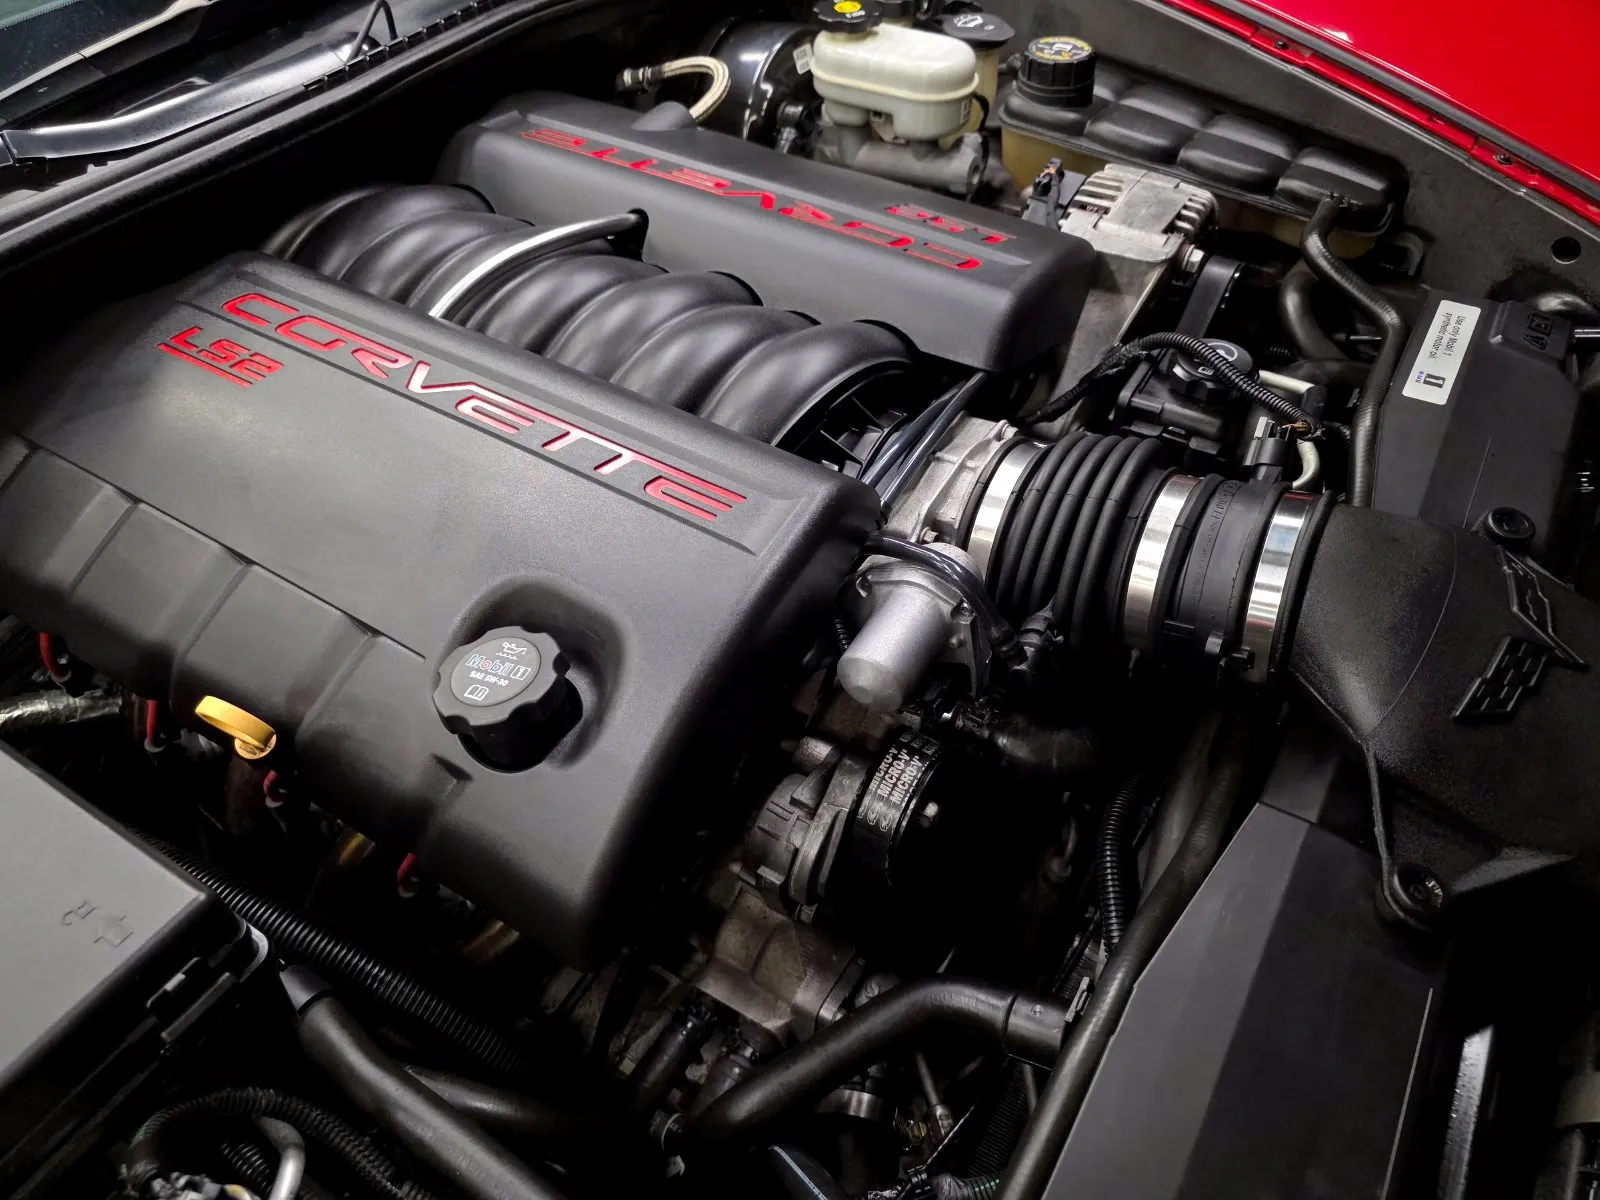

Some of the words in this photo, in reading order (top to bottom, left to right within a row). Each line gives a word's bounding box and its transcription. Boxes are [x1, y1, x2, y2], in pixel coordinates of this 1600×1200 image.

[520, 128, 984, 270] CORVETTE
[1439, 312, 1453, 335] synthetic
[1455, 315, 1467, 326] Use
[1449, 326, 1461, 337] only
[1432, 335, 1444, 351] motor
[1445, 337, 1458, 352] Mobil
[168, 325, 285, 383] LS2
[221, 292, 748, 521] CORVETTE
[465, 653, 515, 676] Mobil
[469, 670, 486, 681] SAE
[484, 674, 509, 687] 5W-30
